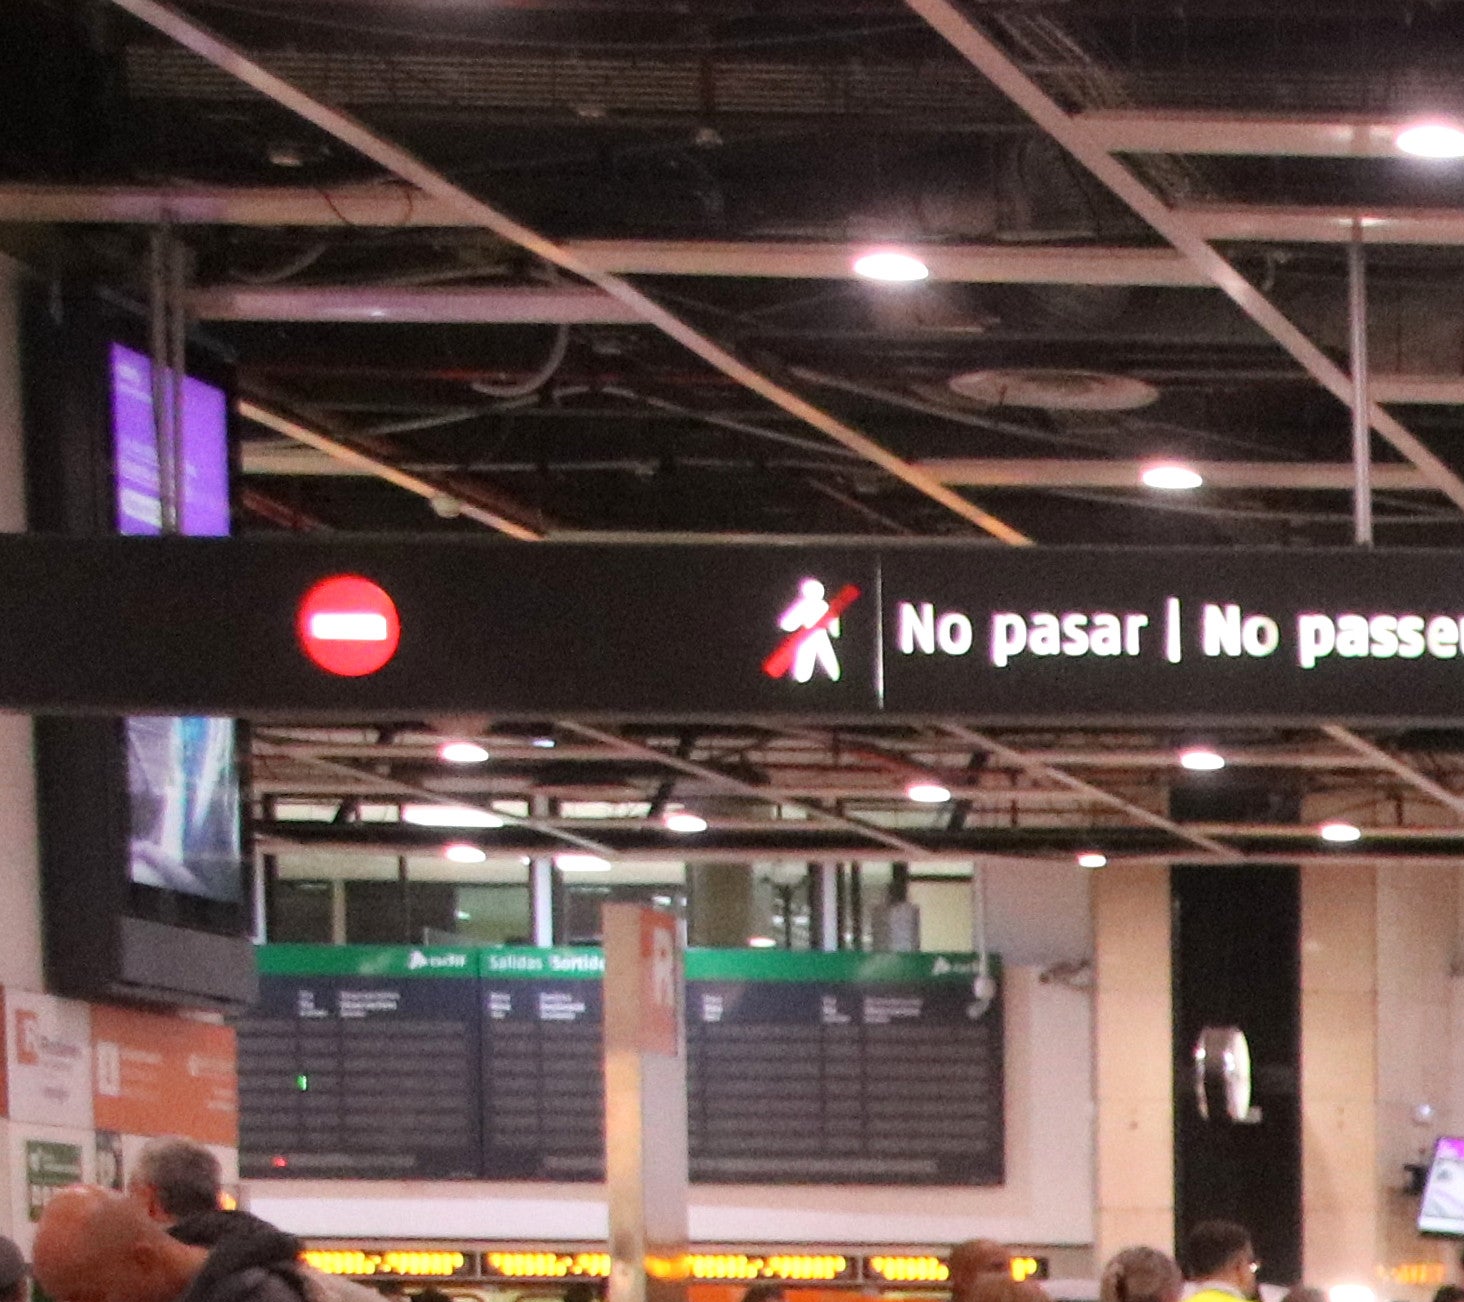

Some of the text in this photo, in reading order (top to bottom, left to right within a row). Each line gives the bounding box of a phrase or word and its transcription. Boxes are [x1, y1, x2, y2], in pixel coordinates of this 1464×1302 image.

[900, 601, 973, 656] No
[990, 611, 1149, 668] pasar
[1202, 603, 1280, 657] No
